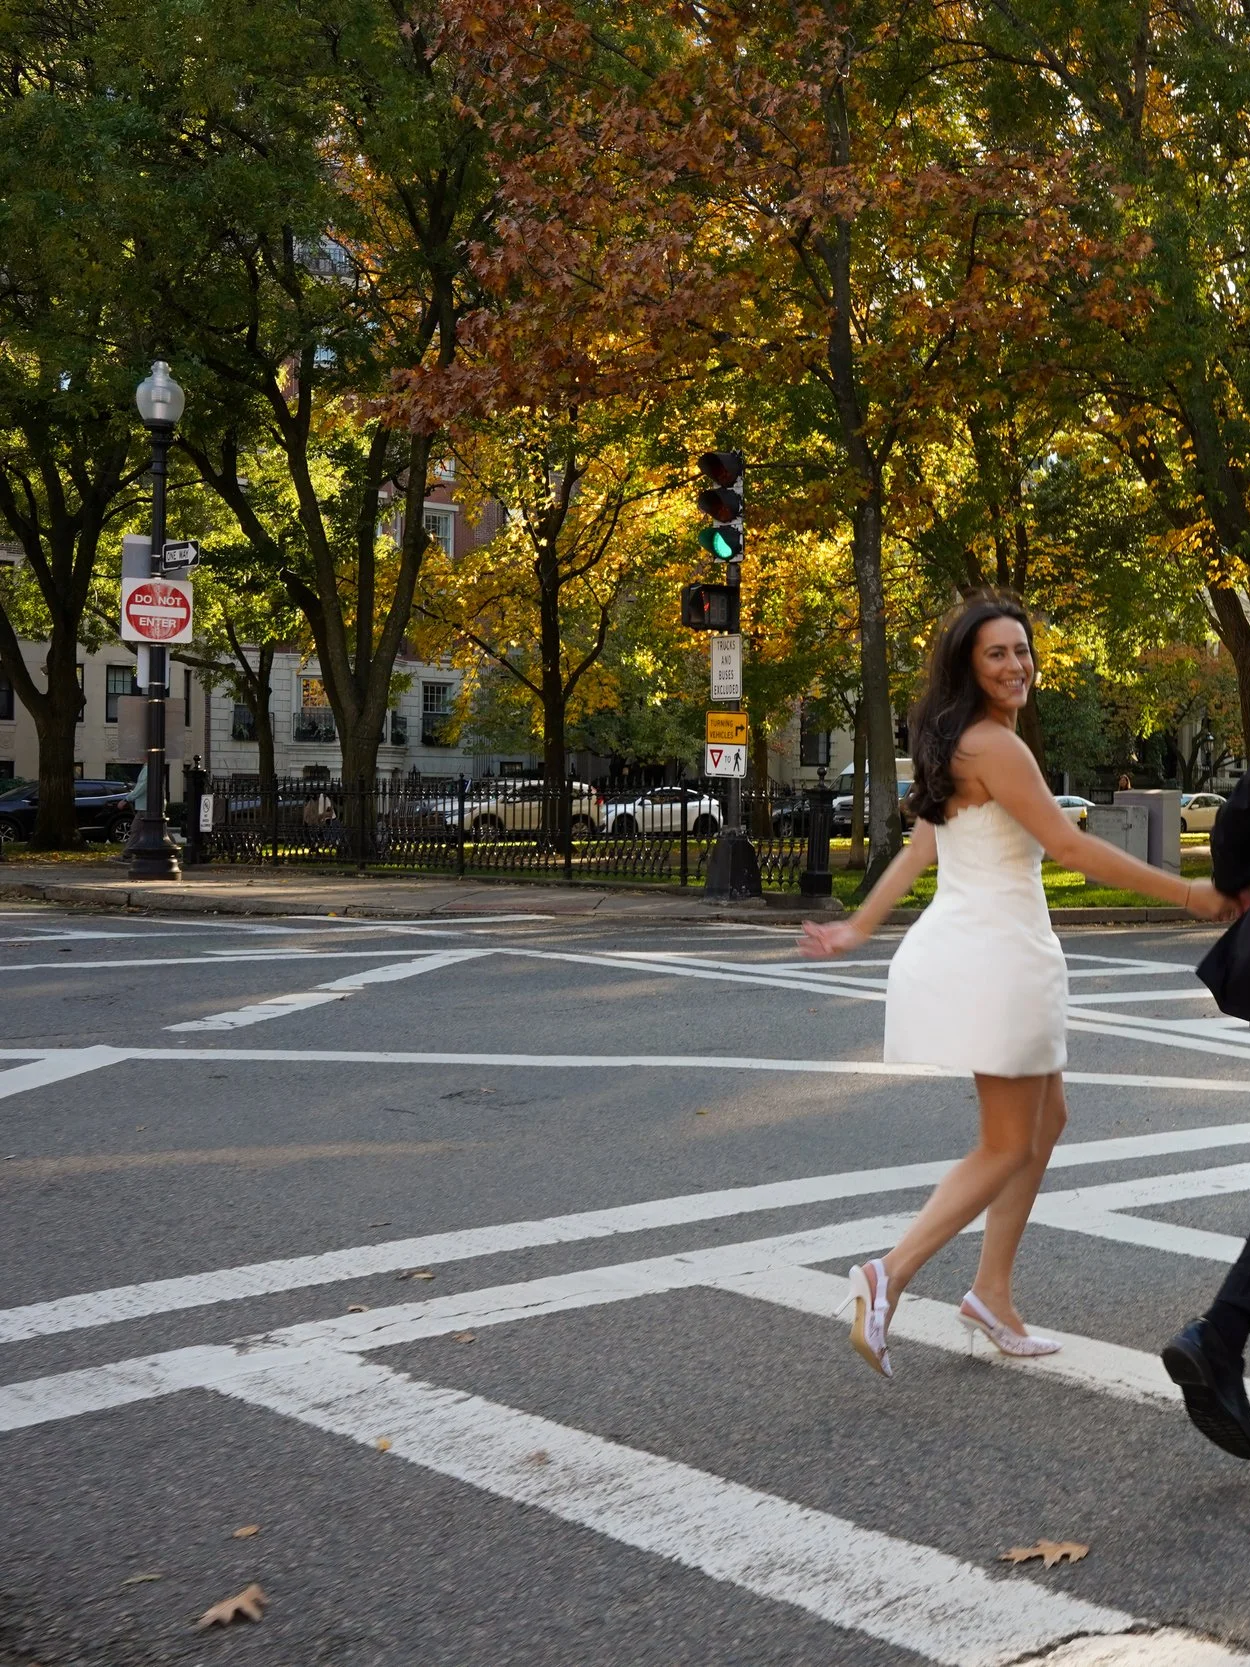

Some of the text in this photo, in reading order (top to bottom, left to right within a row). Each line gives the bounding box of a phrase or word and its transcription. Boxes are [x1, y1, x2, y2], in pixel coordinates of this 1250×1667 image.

[166, 549, 189, 561] ONE WAY
[135, 594, 182, 606] DO NOT
[139, 618, 176, 628] ENTER
[717, 640, 736, 650] TRUCKS
[721, 656, 731, 666] AND
[718, 670, 734, 680] BUSES
[714, 684, 738, 695] EXCLUDED
[710, 720, 734, 728] TURNING
[724, 756, 732, 764] TO
